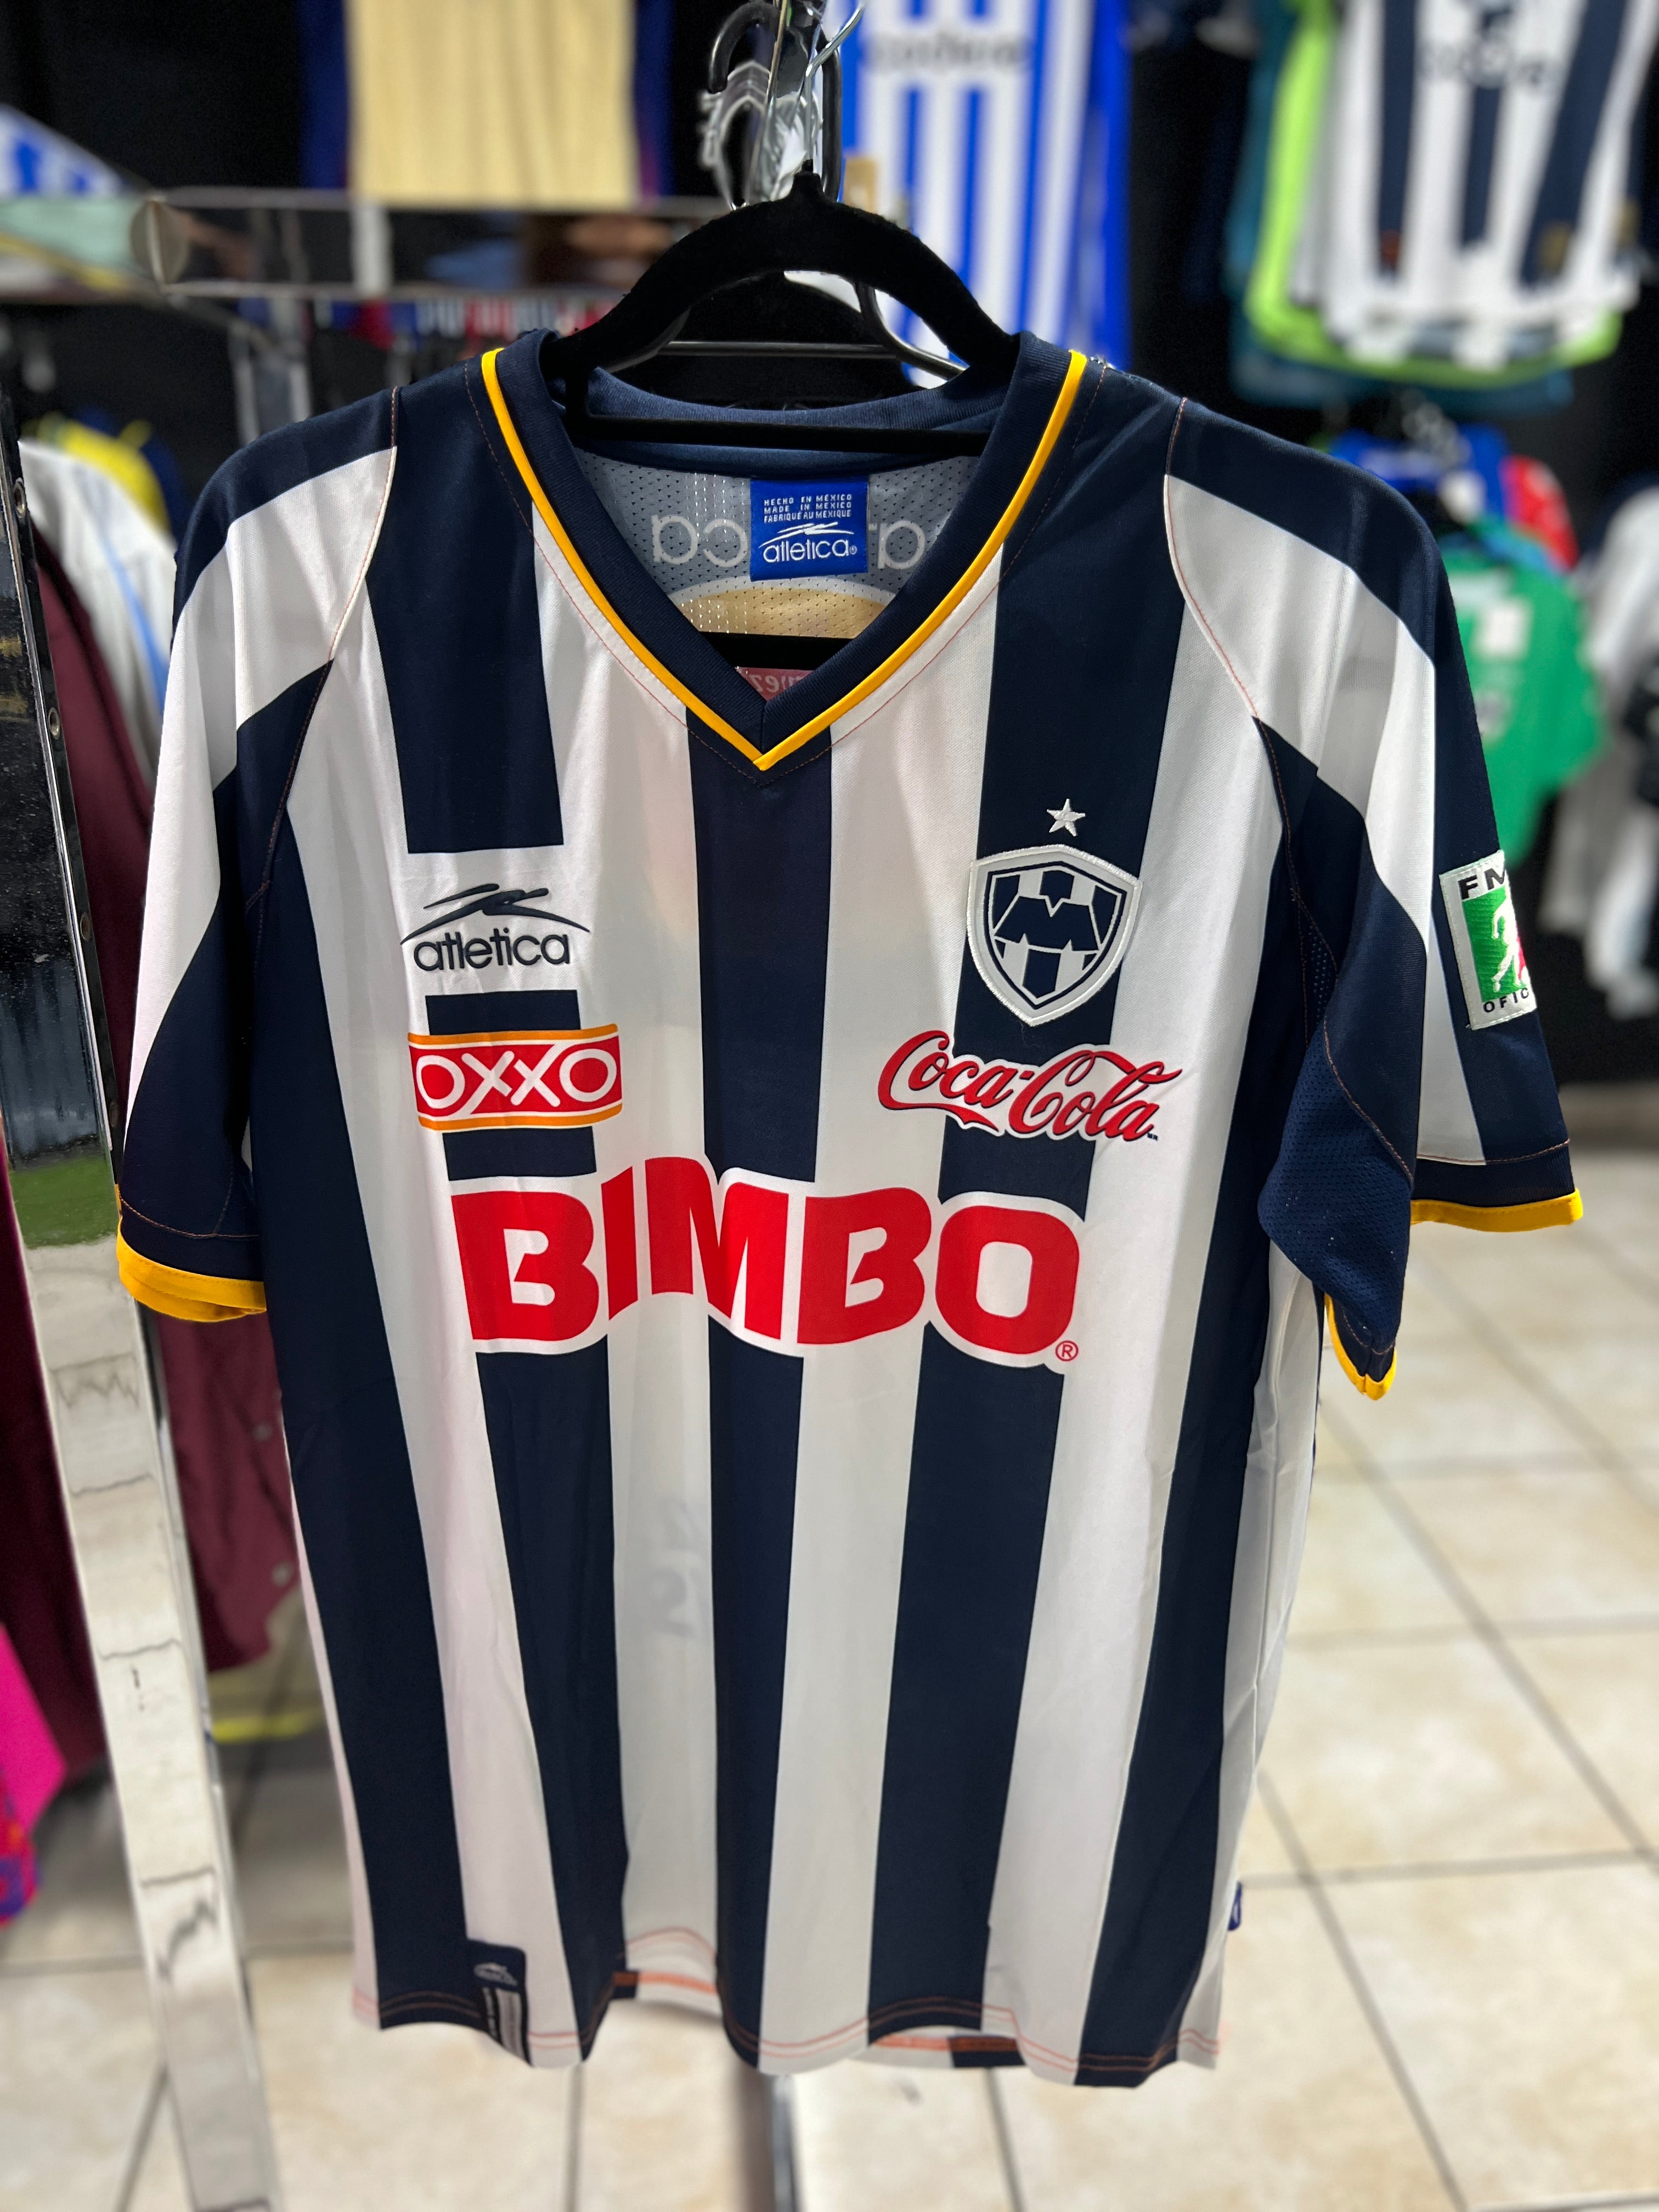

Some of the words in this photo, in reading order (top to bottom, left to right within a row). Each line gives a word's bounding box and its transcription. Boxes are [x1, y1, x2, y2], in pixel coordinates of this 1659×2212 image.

[764, 498, 794, 506] HECHO
[764, 505, 789, 514] MADE
[803, 511, 814, 520] AU
[816, 510, 851, 518] MEXIQUE
[414, 927, 570, 971] atletica
[1483, 988, 1529, 1013] OFIC
[416, 1042, 617, 1116] OXXO
[878, 1030, 1183, 1141] Coca-Cola
[450, 1156, 1080, 1355] BIMBO
